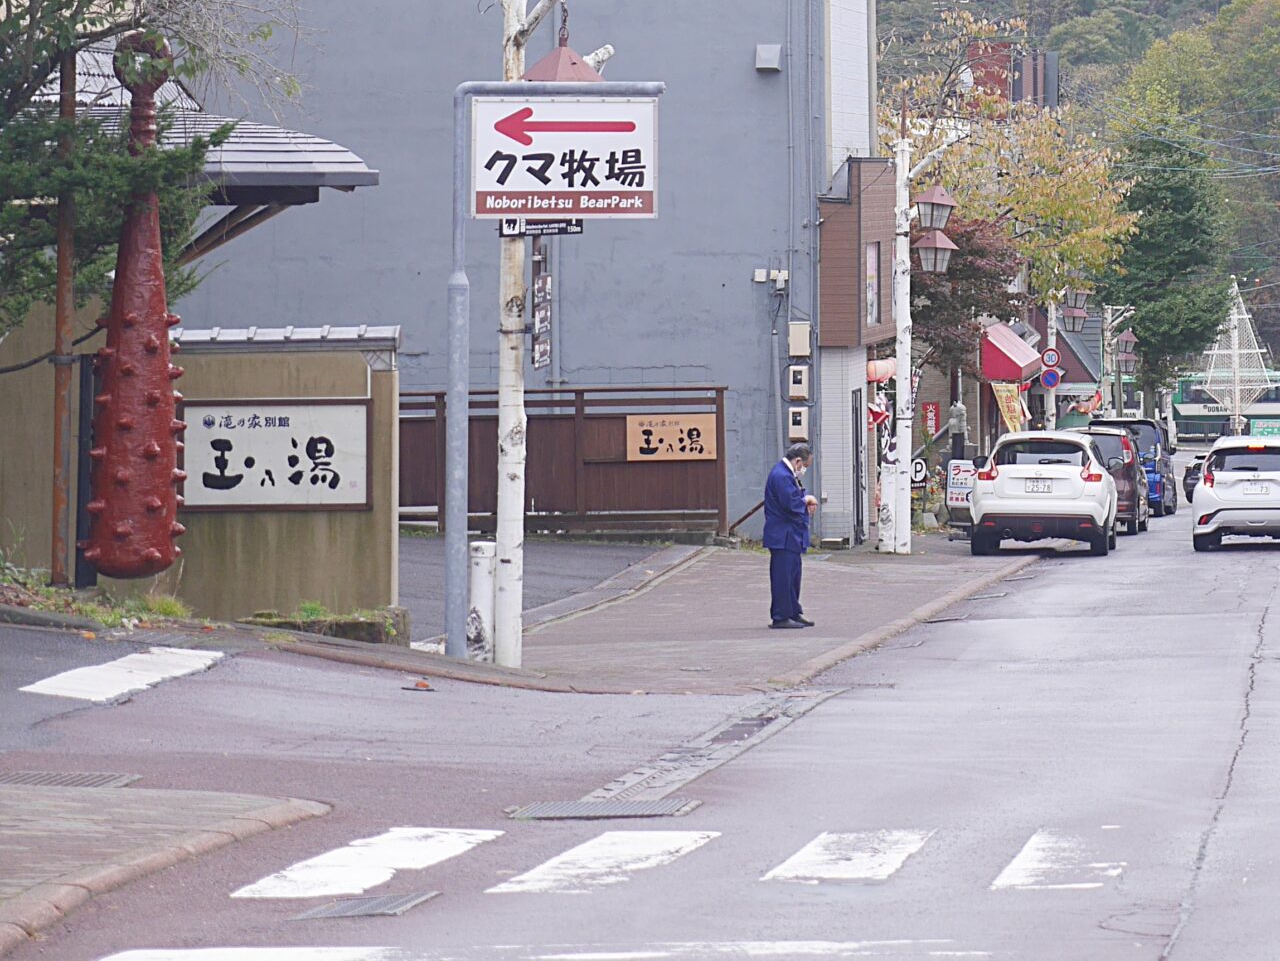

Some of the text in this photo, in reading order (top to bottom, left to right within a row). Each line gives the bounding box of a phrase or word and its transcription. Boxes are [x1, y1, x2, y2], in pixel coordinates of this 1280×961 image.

[484, 149, 646, 188] クマ牧場
[486, 196, 573, 208] Noboribetsu
[1045, 354, 1056, 363] 30
[914, 462, 923, 479] P
